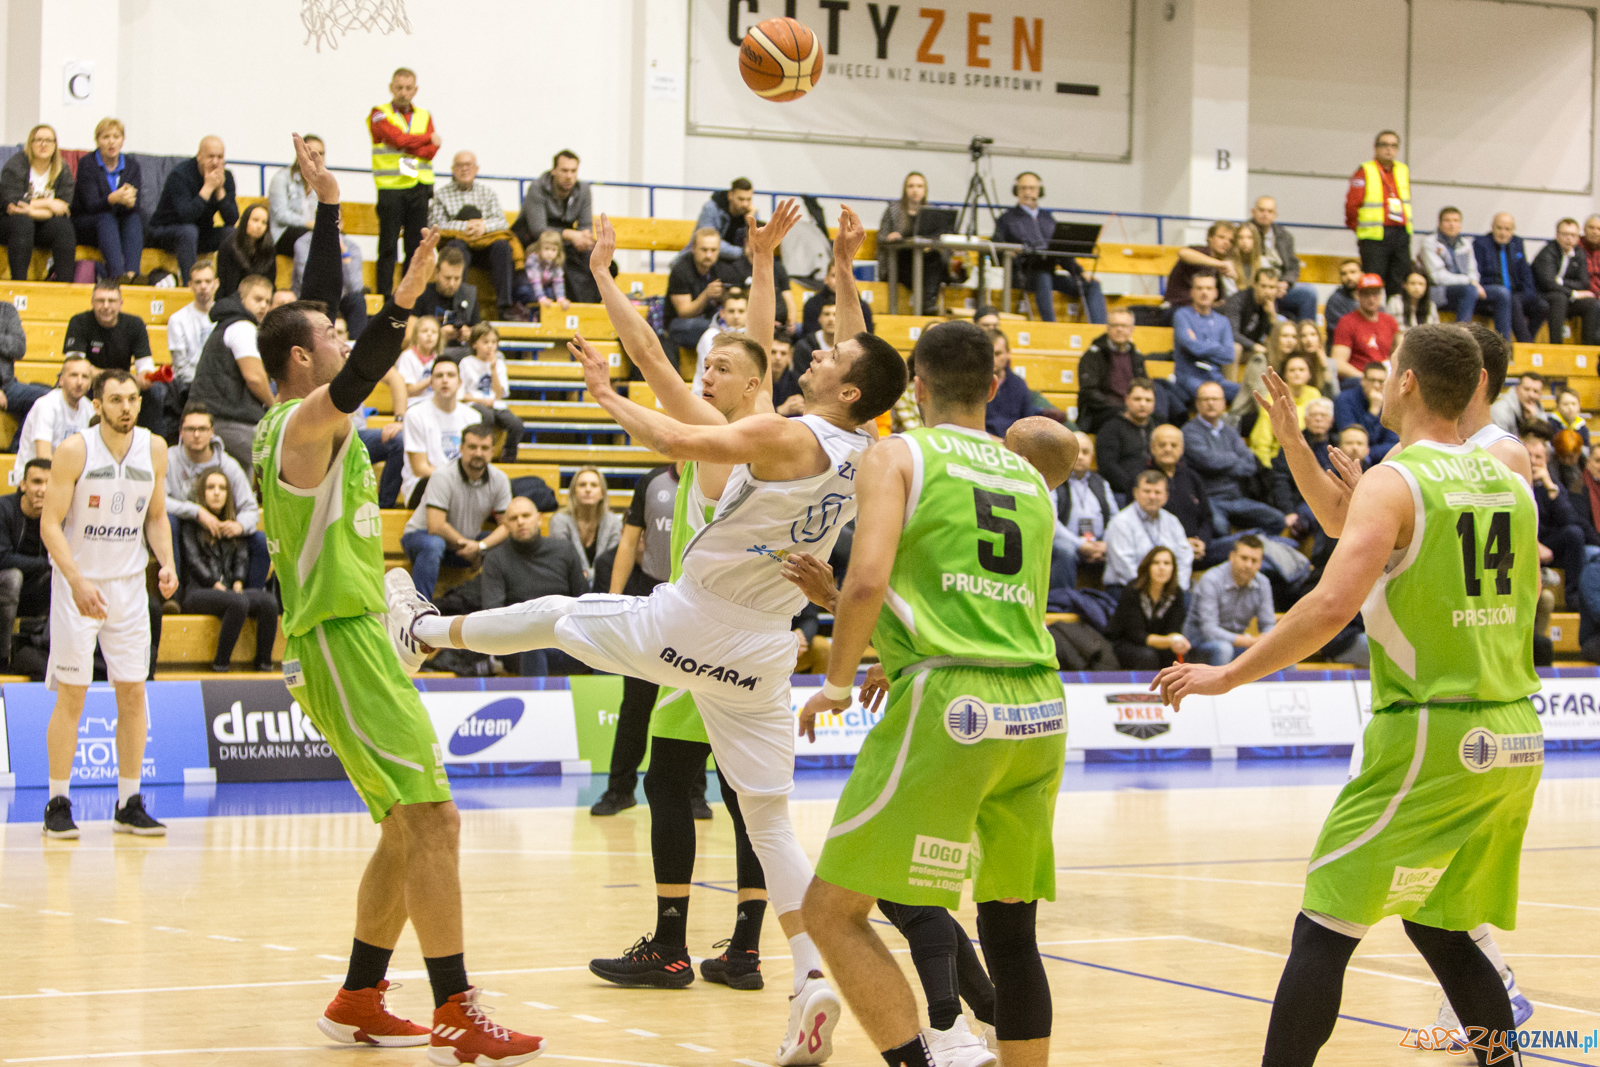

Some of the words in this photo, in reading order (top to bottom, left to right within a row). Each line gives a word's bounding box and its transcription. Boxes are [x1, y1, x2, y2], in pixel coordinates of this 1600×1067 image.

[68, 73, 91, 100] C
[919, 69, 956, 85] KLUB
[964, 74, 1042, 91] SPORTOWY
[1217, 149, 1230, 170] B
[111, 492, 125, 514] 8
[973, 487, 1023, 575] 5
[1456, 512, 1515, 597] 14
[1117, 707, 1165, 721] JOKER
[458, 716, 512, 737] atrem
[219, 744, 301, 760] DRUKARNIA
[919, 841, 963, 864] LOGO
